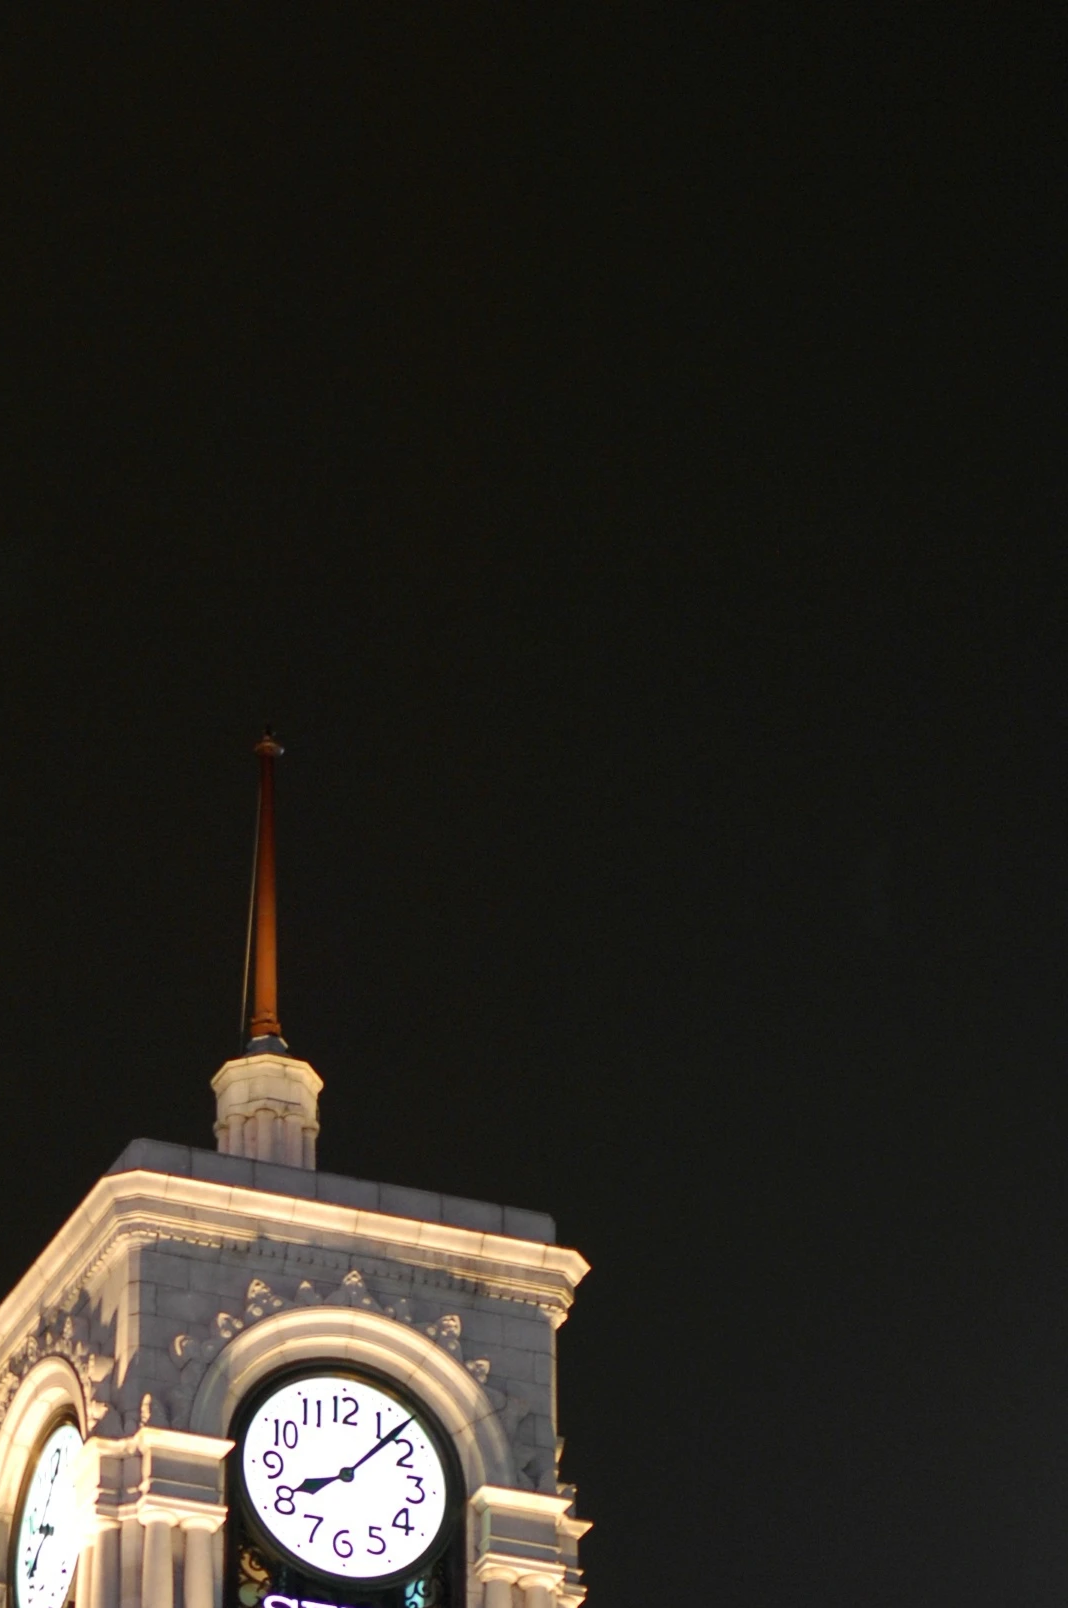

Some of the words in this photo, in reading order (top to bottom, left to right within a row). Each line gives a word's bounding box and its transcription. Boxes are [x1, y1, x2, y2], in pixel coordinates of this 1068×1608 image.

[303, 1398, 321, 1428] 11
[333, 1396, 359, 1426] 12
[274, 1419, 298, 1449] 10
[263, 1450, 284, 1479] 9
[394, 1438, 413, 1468] 2
[274, 1485, 296, 1515] 8
[406, 1475, 425, 1504] 3
[304, 1514, 324, 1543] 7
[392, 1508, 415, 1536] 4
[333, 1530, 353, 1558] 6
[367, 1526, 386, 1555] 5
